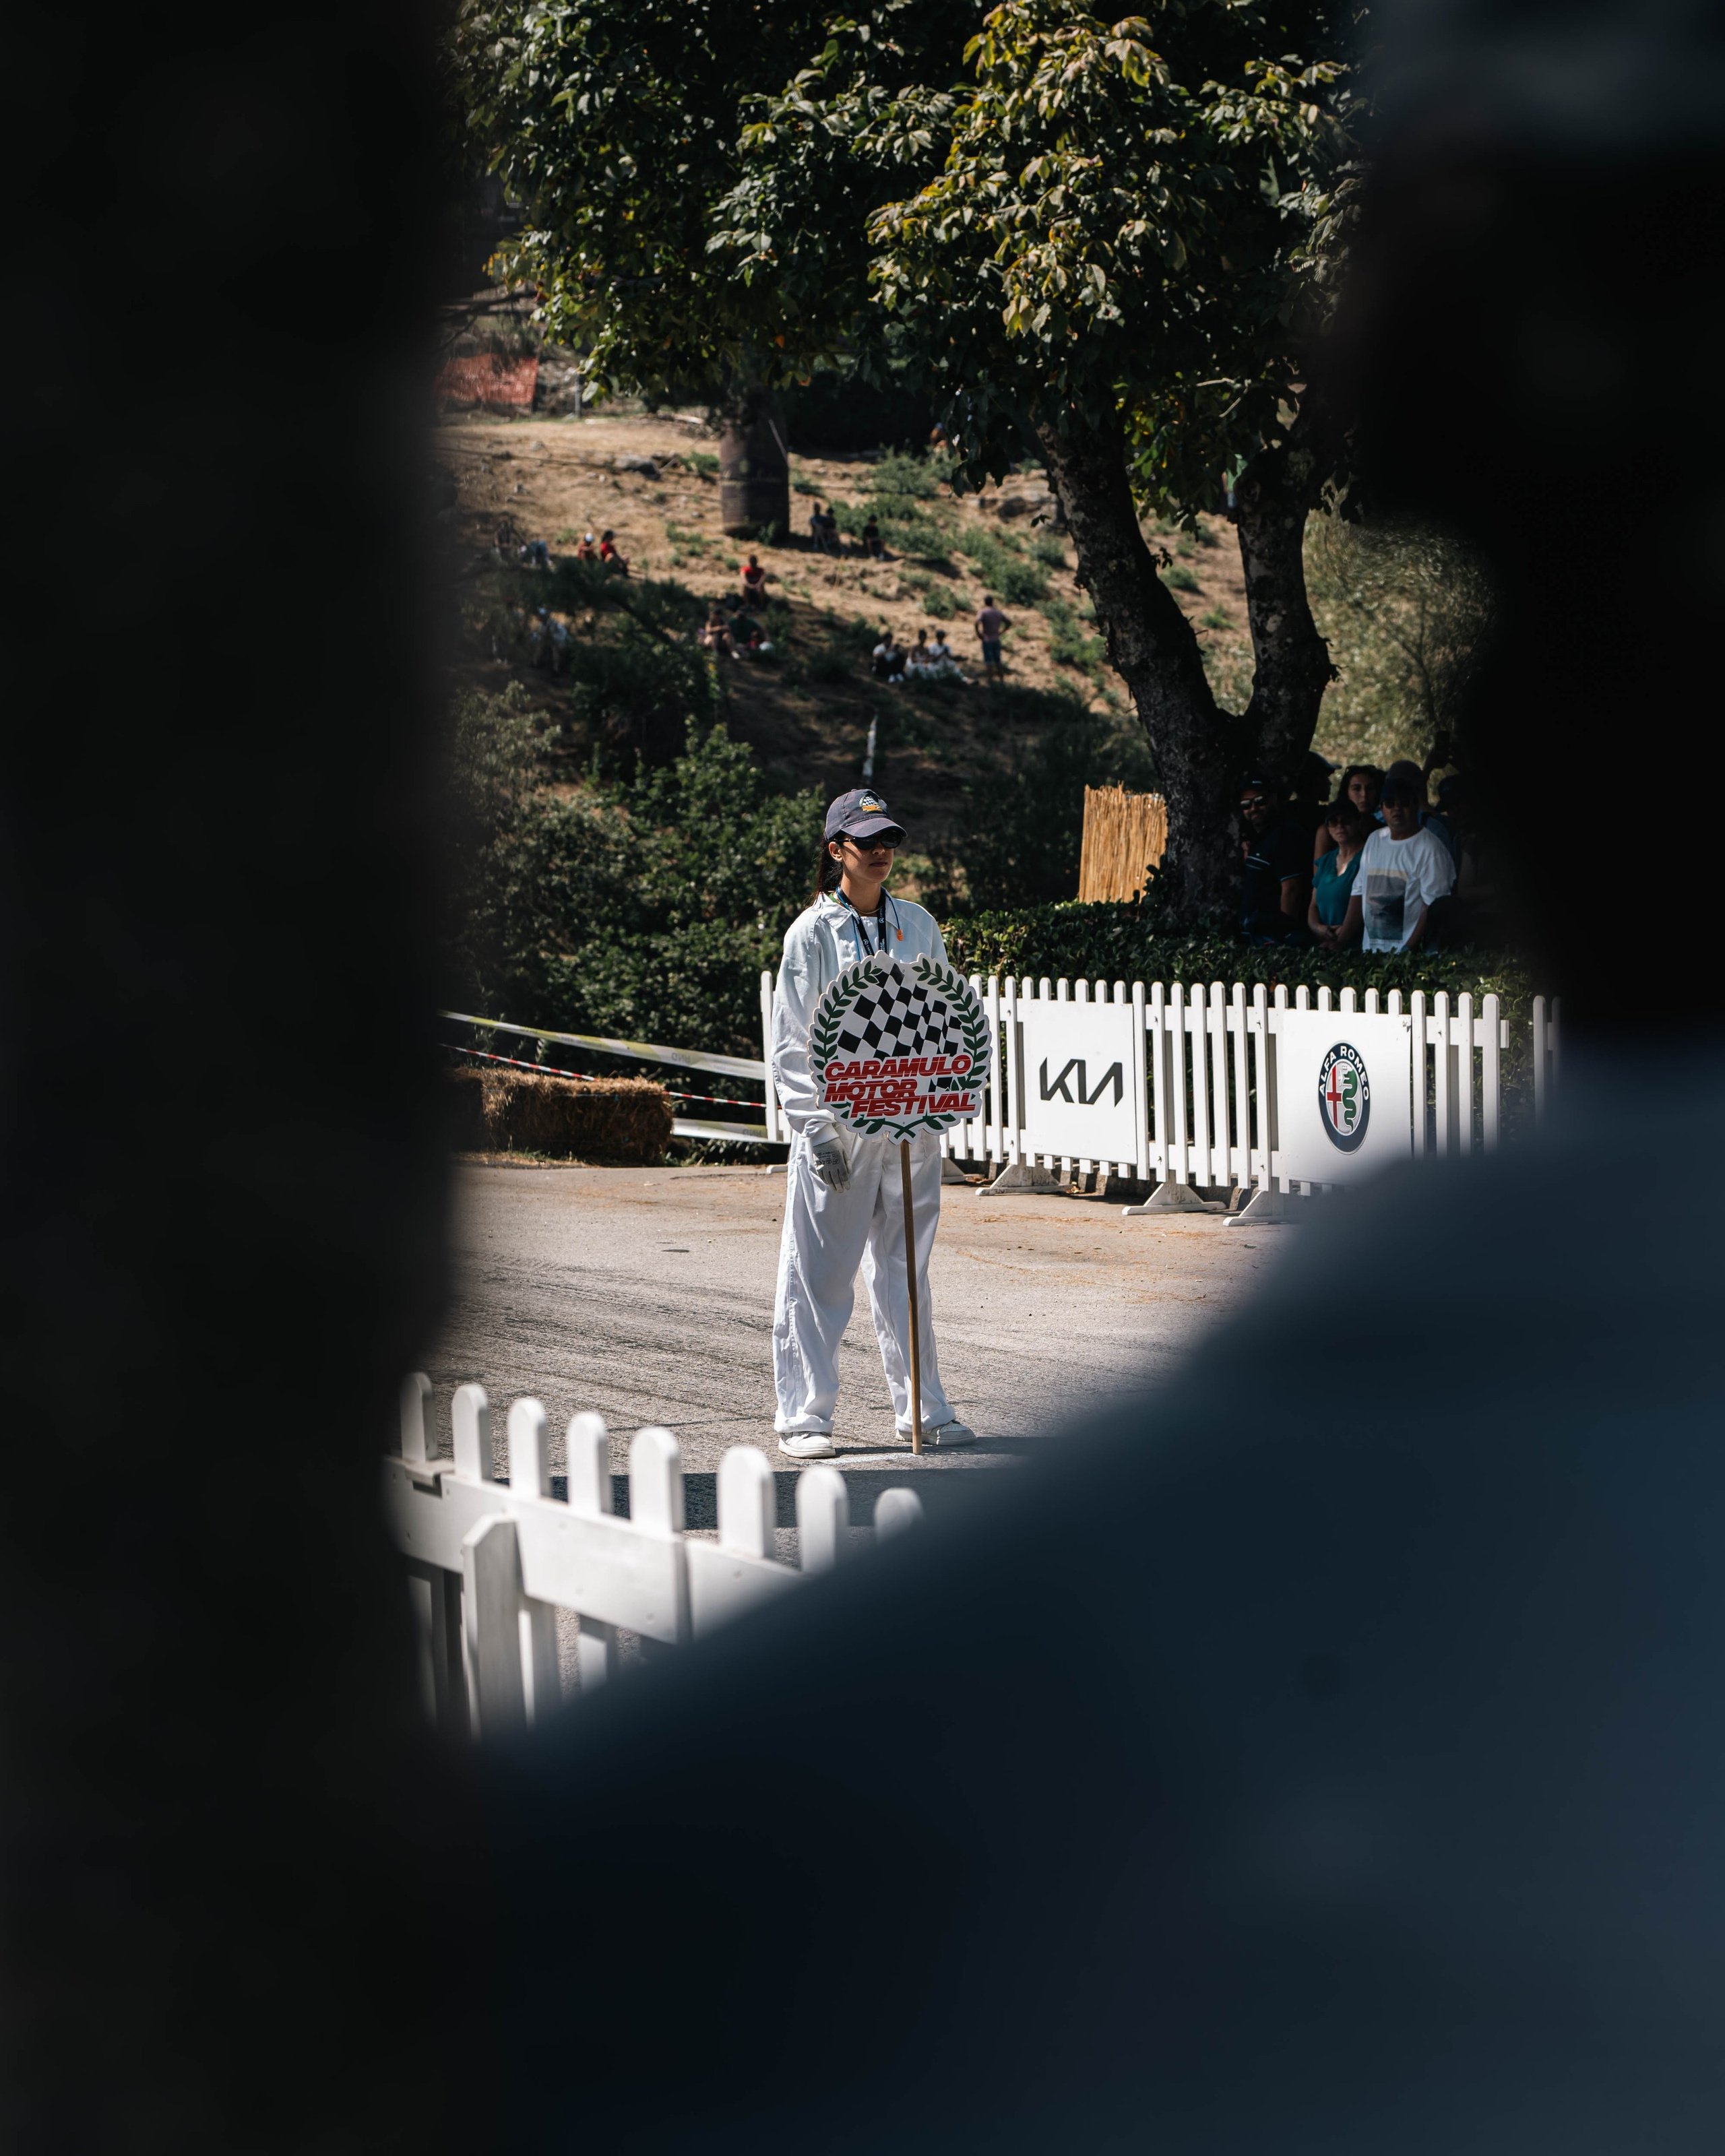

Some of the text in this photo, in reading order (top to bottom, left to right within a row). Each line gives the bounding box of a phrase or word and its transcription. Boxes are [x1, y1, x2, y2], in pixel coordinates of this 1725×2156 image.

[825, 1054, 971, 1082] CARAMULO
[1040, 1056, 1123, 1108] KIA
[1319, 1046, 1369, 1101] ALFA ROMEO
[824, 1079, 918, 1102] MOTOR
[850, 1092, 976, 1118] FESTIVAL
